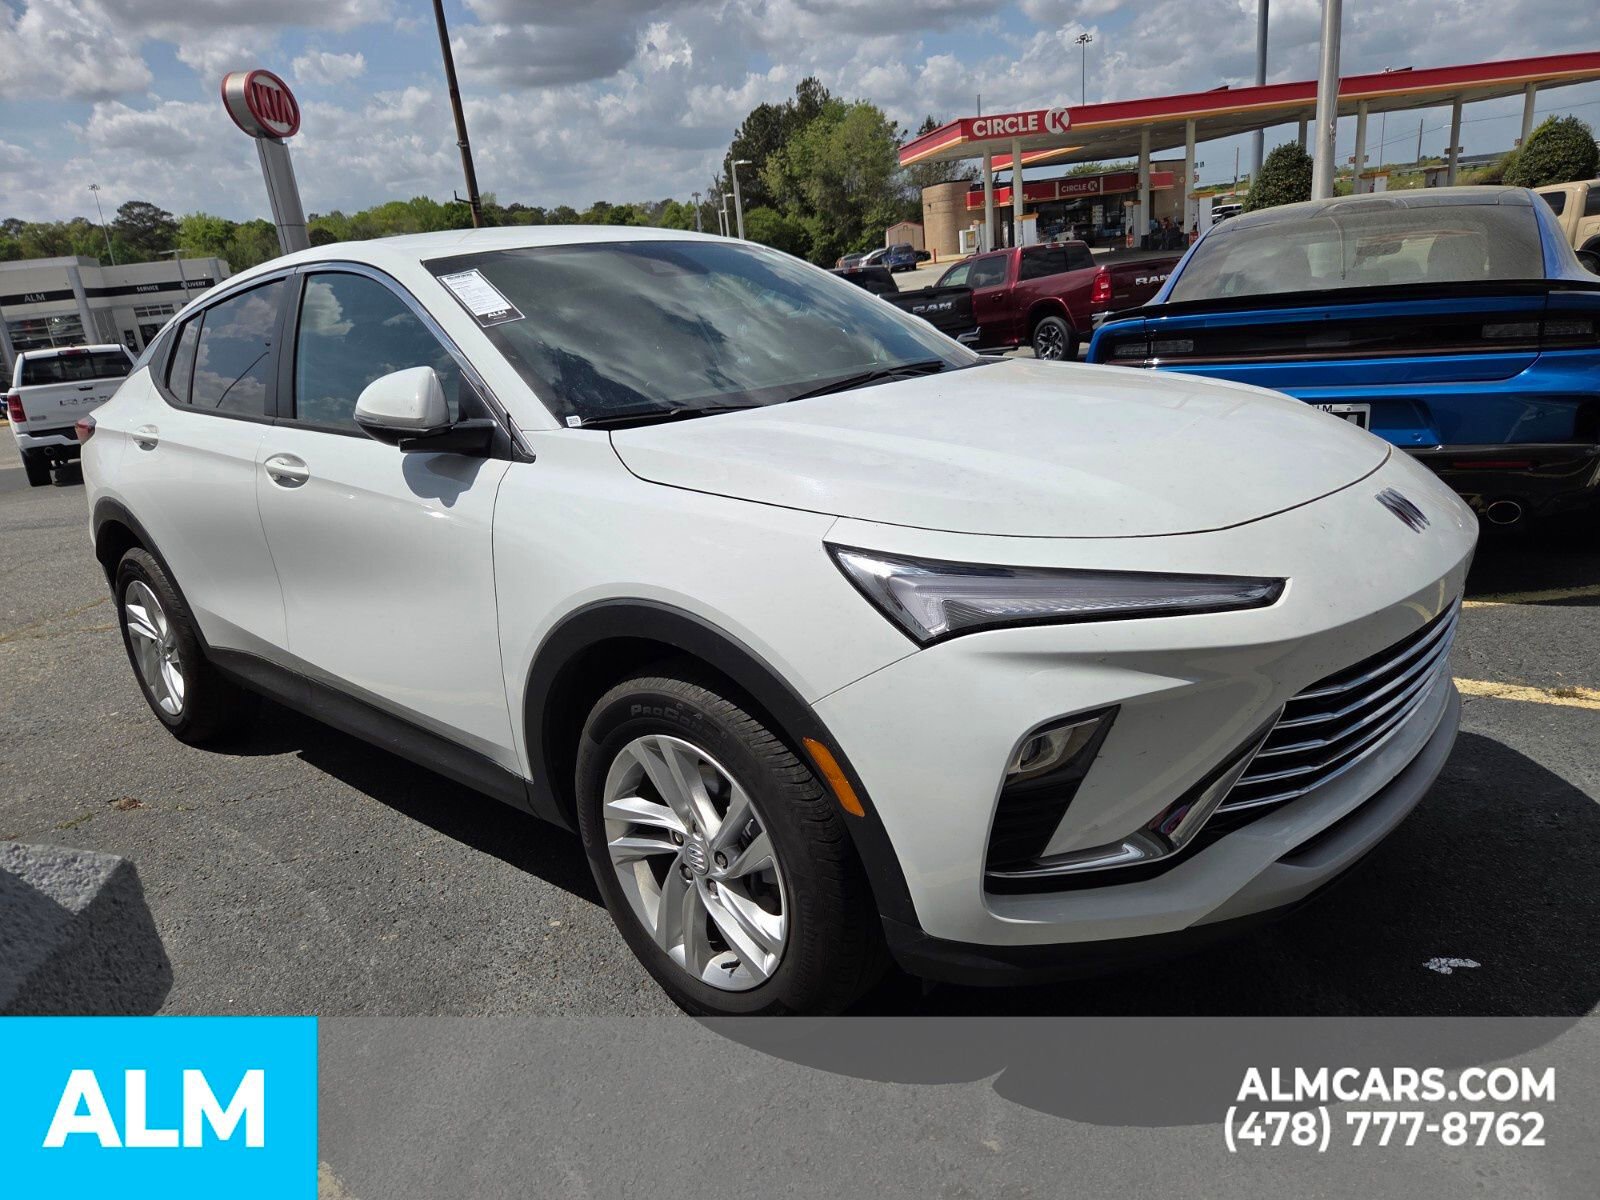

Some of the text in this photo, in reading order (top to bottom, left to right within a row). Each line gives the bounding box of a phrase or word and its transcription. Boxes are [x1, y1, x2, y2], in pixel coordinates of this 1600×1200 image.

[252, 82, 295, 127] KIA
[972, 109, 1070, 137] CIRCLE K
[1061, 181, 1097, 192] CIRCLE K
[24, 293, 46, 303] ALM
[912, 302, 953, 313] RAM
